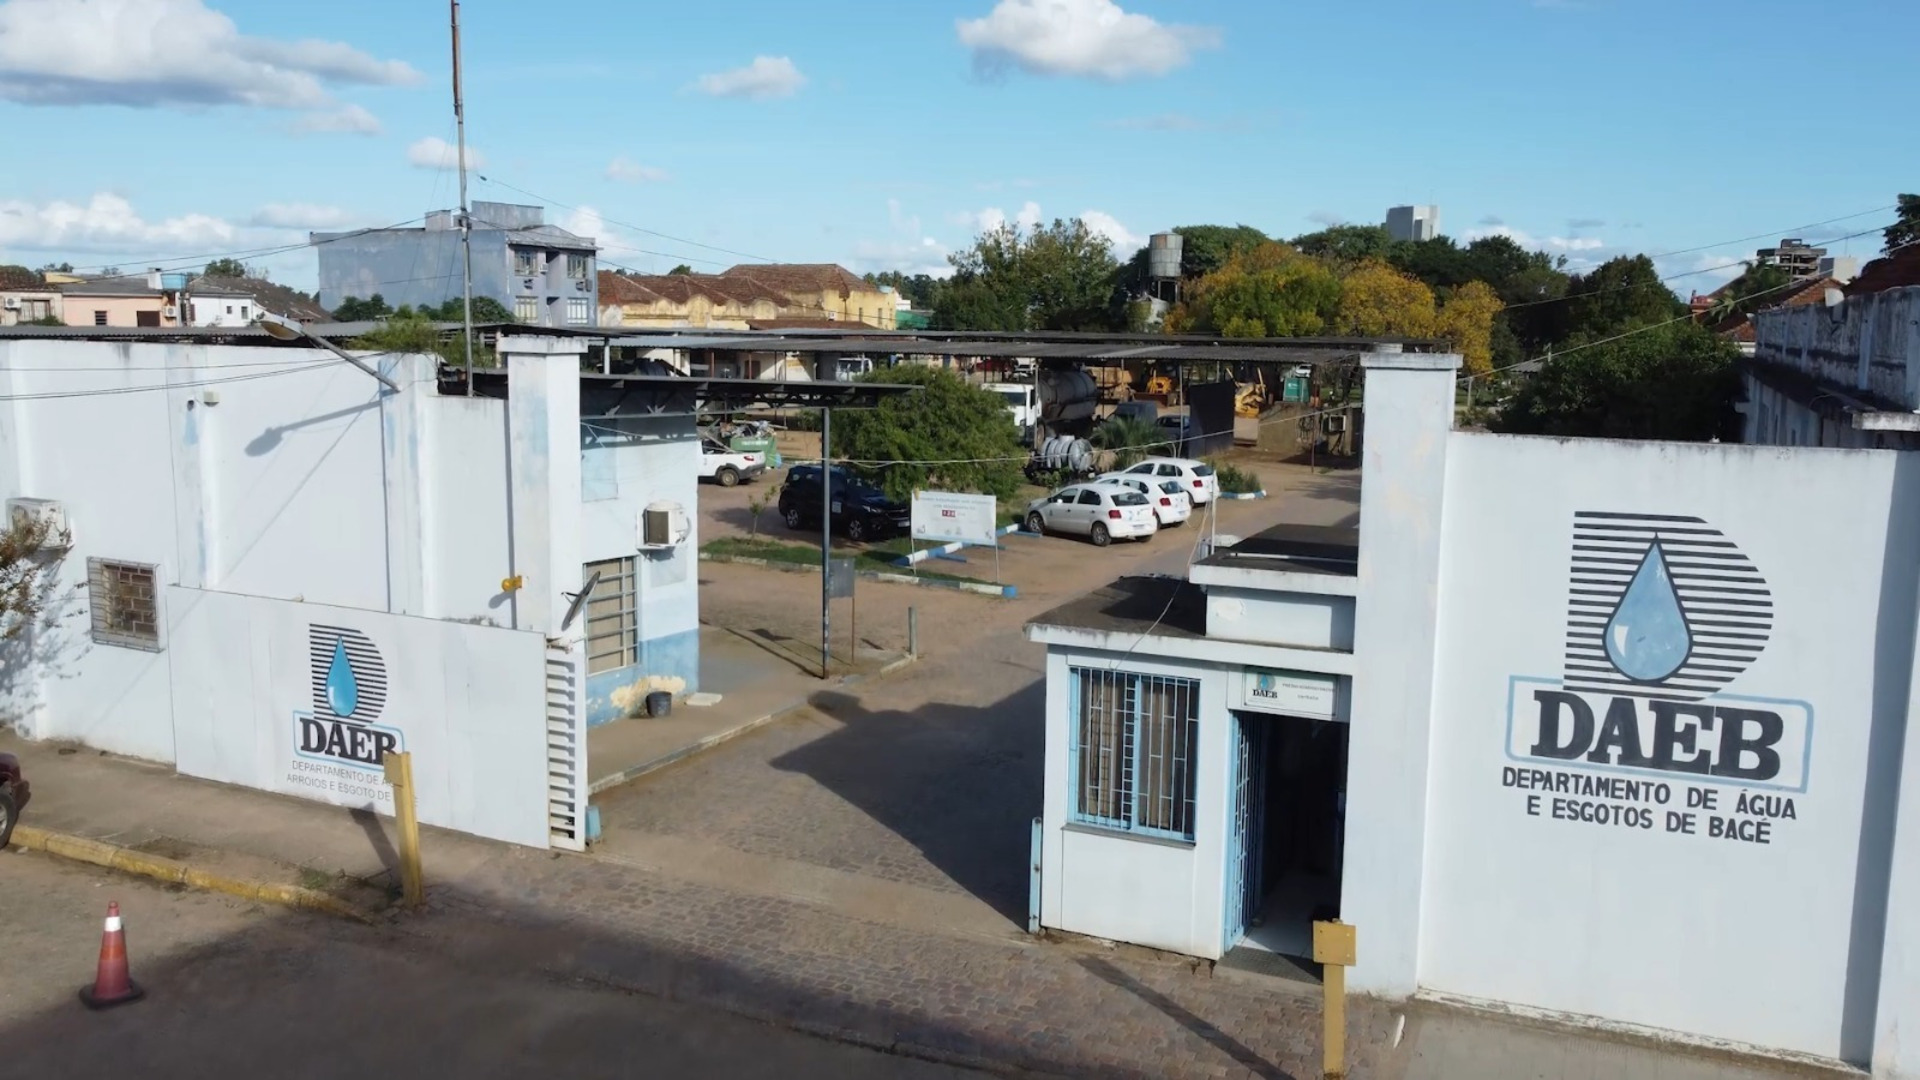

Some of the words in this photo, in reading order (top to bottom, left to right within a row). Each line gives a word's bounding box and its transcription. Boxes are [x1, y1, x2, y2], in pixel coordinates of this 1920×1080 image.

[1252, 688, 1278, 699] DAEB
[1530, 689, 1784, 781] DAEB
[286, 773, 327, 790] ARROIOS
[329, 780, 336, 791] E
[338, 783, 375, 799] ESGOTO
[377, 790, 391, 801] DE
[292, 760, 364, 783] DEPARTAMENTO
[366, 773, 380, 786] DE
[1502, 766, 1671, 805] DEPARTAMENTO
[1686, 787, 1718, 811] DE
[1735, 788, 1797, 820] ÁGUA
[1527, 795, 1541, 816] E
[1552, 798, 1653, 829] ESGOTOS
[1666, 811, 1696, 835] DE
[1708, 816, 1771, 844] BAGÉ
